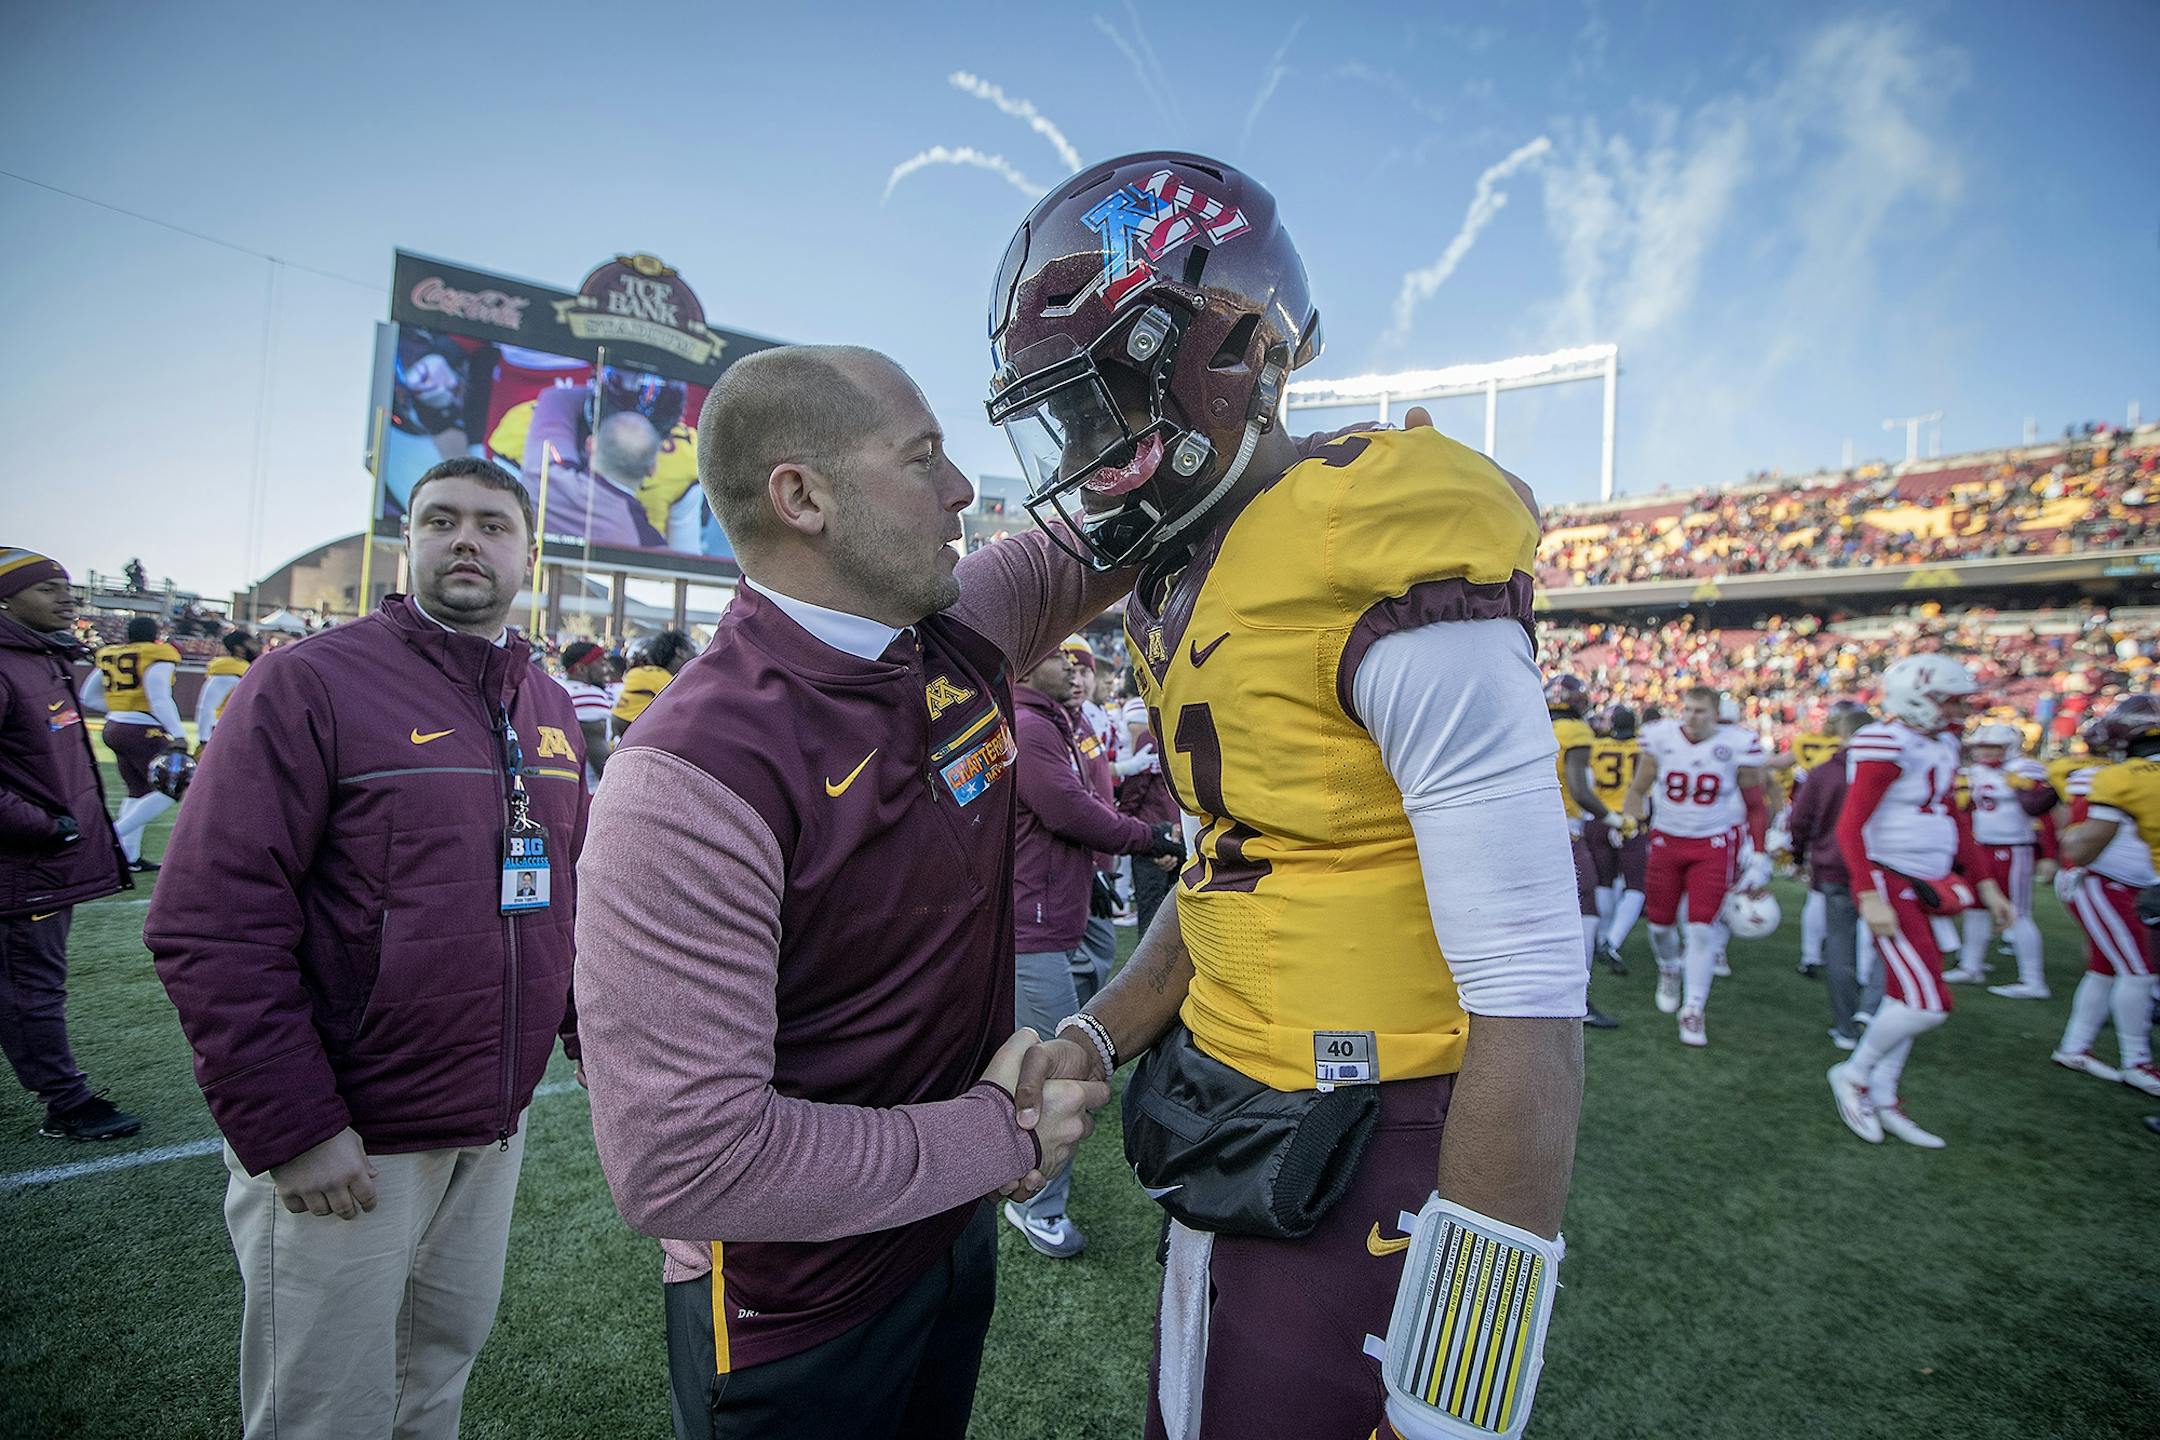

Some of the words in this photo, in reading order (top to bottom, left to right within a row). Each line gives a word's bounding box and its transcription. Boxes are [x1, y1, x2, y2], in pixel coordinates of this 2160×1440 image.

[608, 290, 679, 327] BANK
[1666, 771, 1720, 804] 88
[1327, 1040, 1354, 1057] 40
